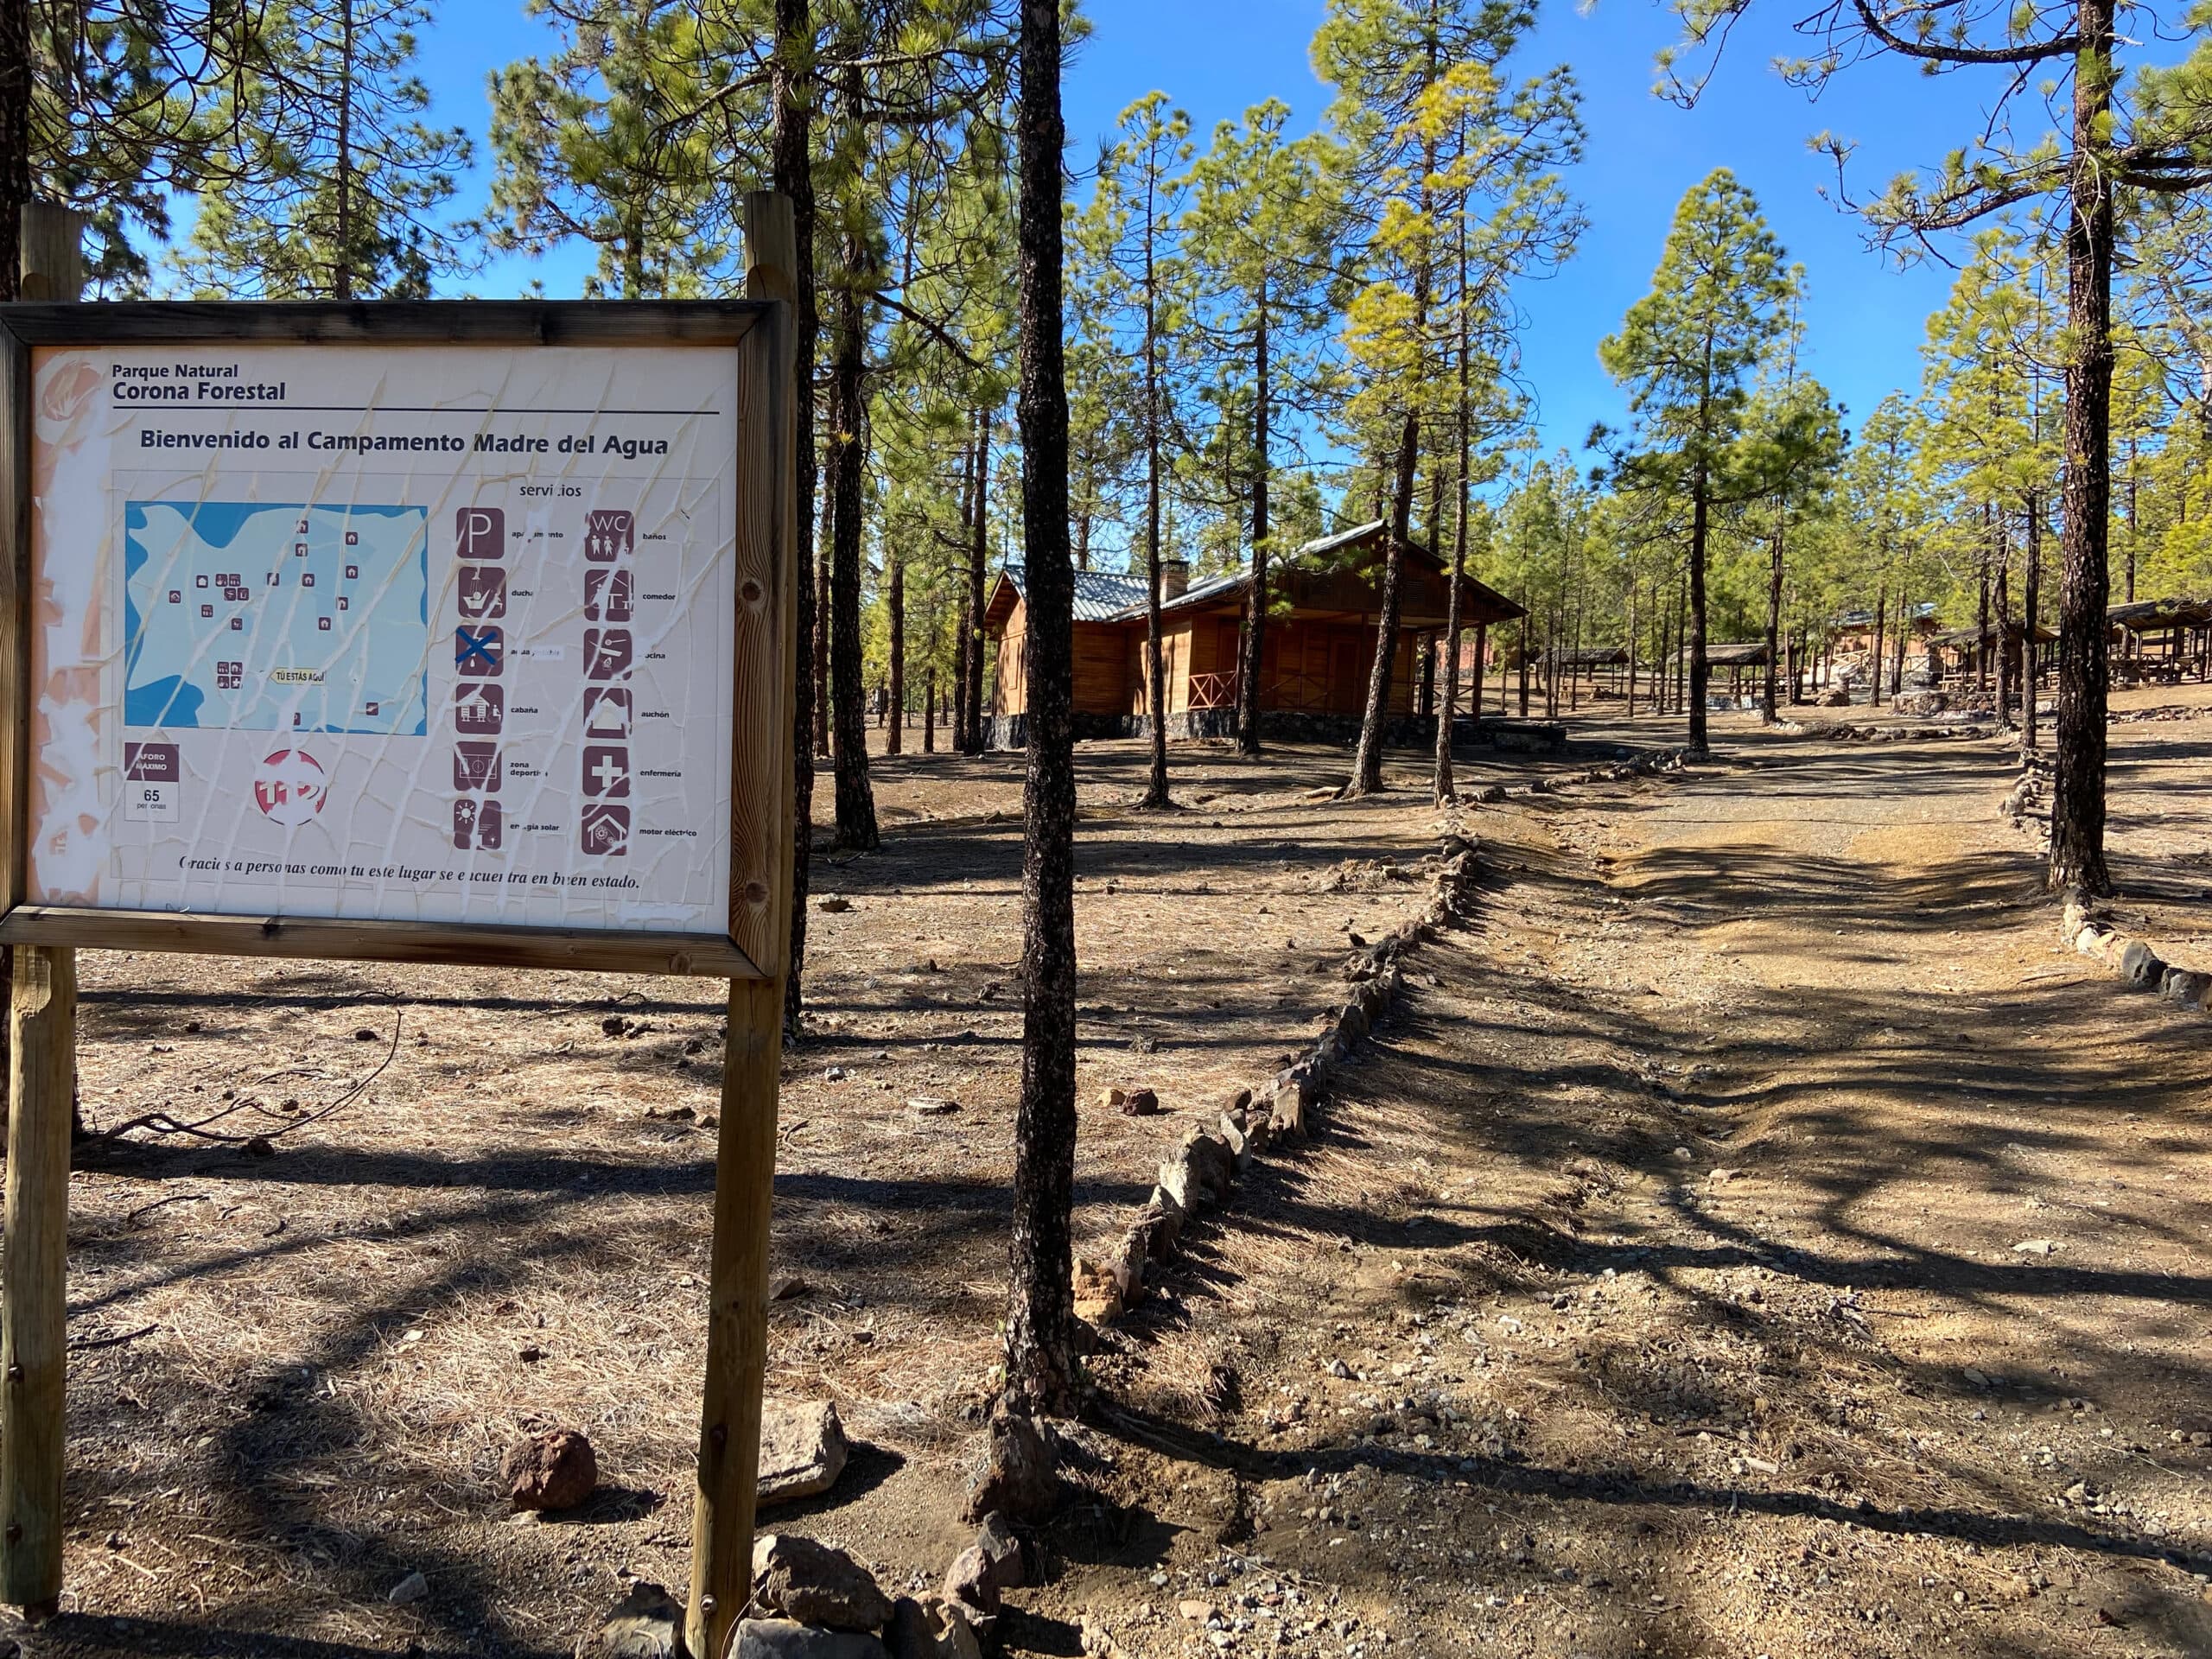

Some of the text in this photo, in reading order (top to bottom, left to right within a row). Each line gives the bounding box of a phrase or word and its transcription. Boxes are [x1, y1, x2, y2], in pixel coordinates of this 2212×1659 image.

[112, 364, 238, 381] Parque Natural
[112, 381, 286, 401] Corona Forestal
[140, 429, 669, 460] Bienvenido al Campamento Madre del Agua
[518, 483, 582, 498] serviios
[592, 515, 627, 532] WC
[642, 532, 667, 541] baños
[639, 769, 682, 778] enfermería
[143, 789, 160, 802] 65
[234, 861, 242, 872] a
[310, 864, 346, 876] como
[350, 864, 365, 876] tu
[398, 865, 435, 882] lugar
[439, 870, 454, 880] se
[531, 874, 549, 885] en
[591, 874, 640, 888] estado.
